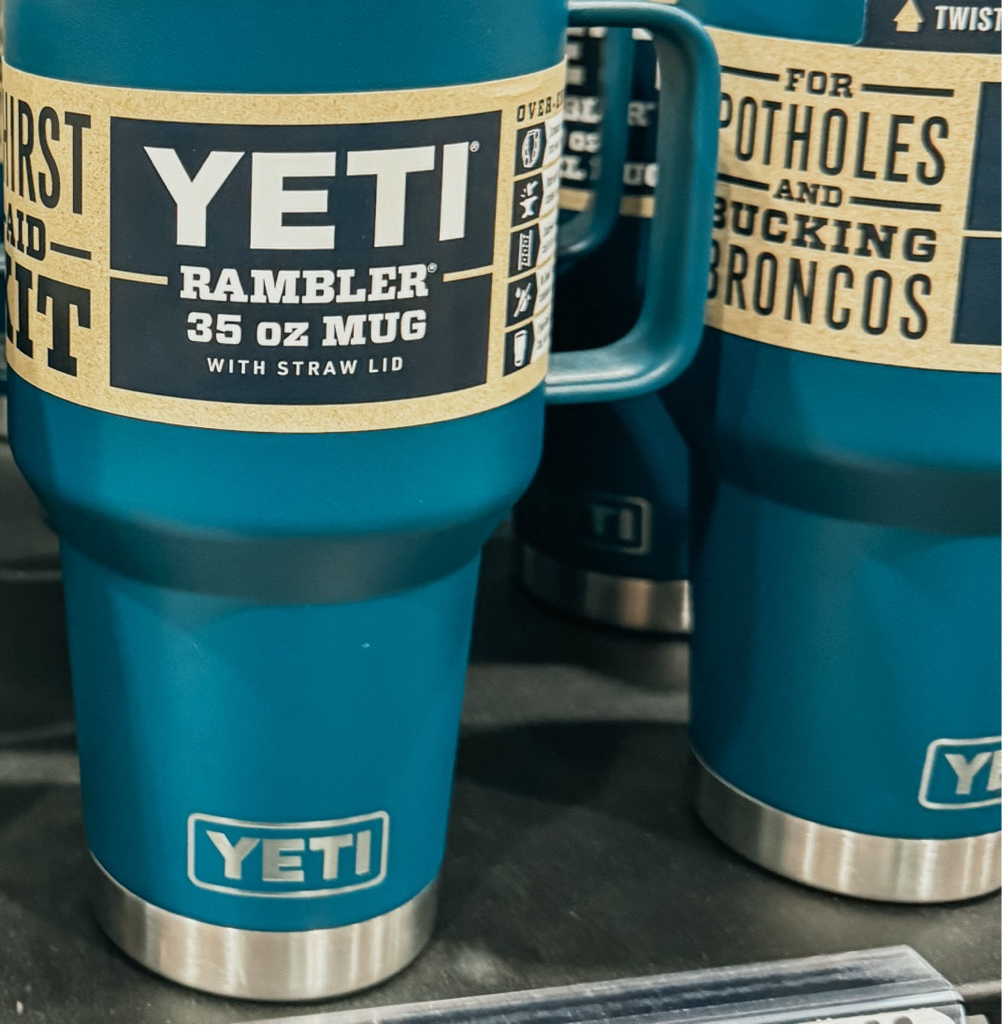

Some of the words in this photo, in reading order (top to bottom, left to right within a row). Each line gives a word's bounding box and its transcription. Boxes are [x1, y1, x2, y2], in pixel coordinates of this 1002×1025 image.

[784, 67, 854, 99] FOR
[772, 179, 843, 208] AND
[6, 203, 46, 262] AID
[713, 196, 937, 263] BUCKING
[186, 312, 242, 345] 35
[256, 321, 310, 347] oz
[322, 309, 427, 347] MUG
[207, 357, 266, 374] WITH
[277, 359, 358, 377] STRAW
[369, 356, 403, 373] LID
[206, 829, 372, 883] YETI
